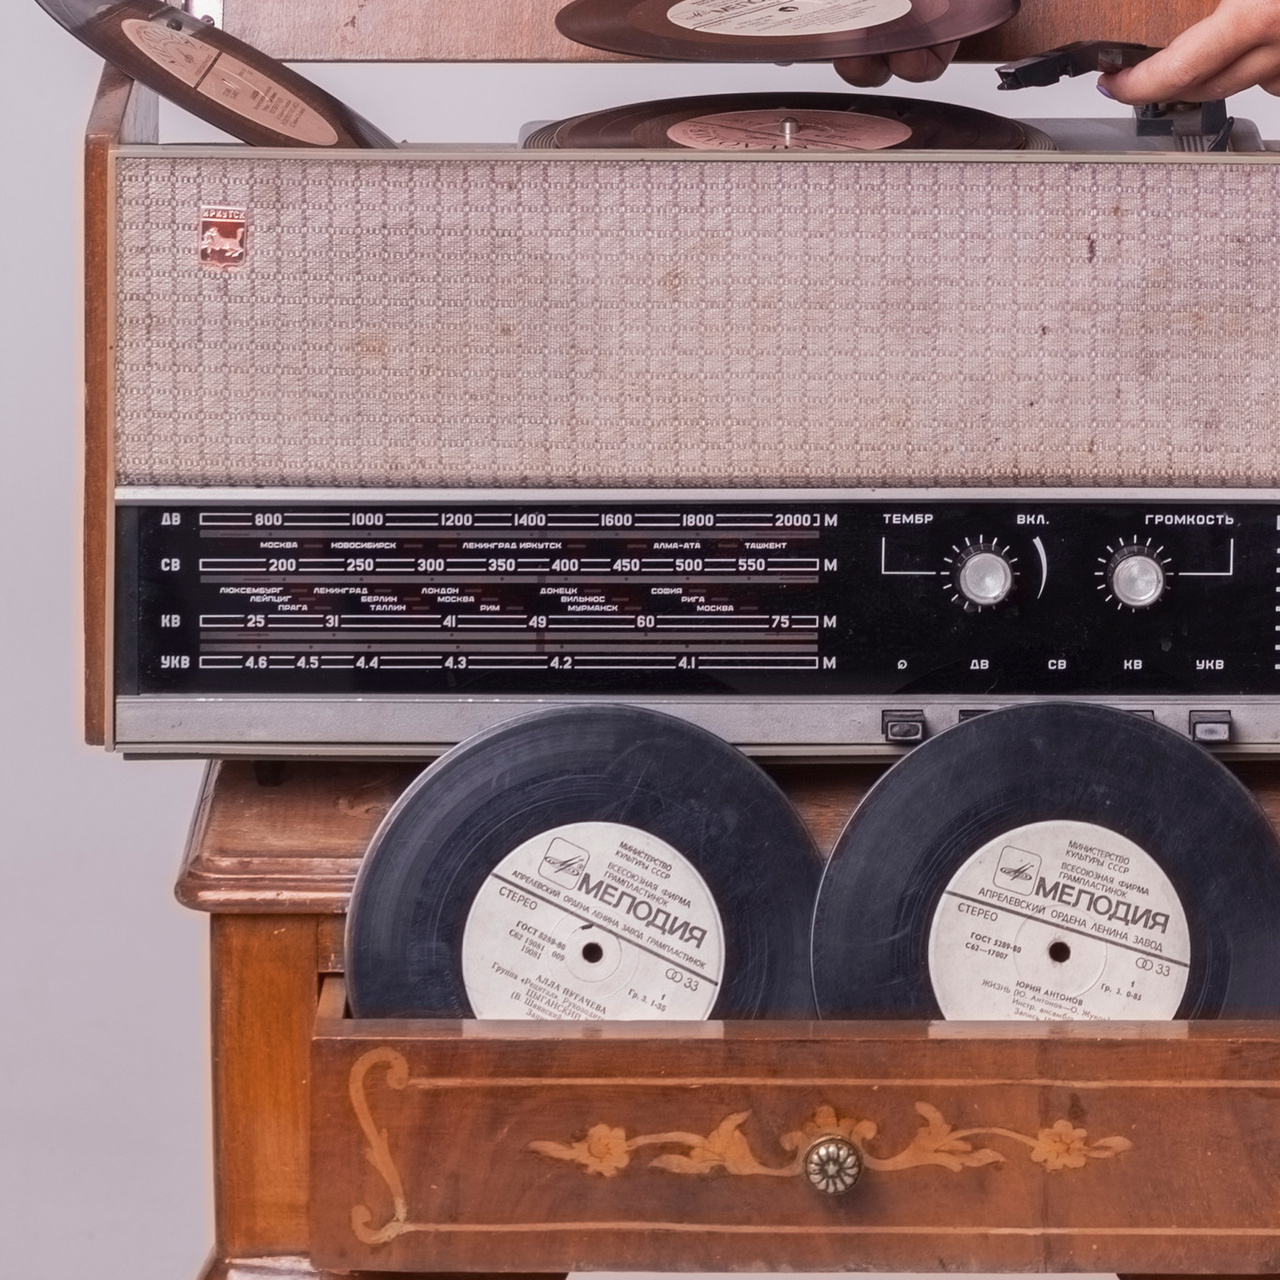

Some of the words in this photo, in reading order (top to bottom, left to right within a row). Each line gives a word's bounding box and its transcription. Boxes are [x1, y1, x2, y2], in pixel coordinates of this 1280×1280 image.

[161, 513, 181, 526] ДВ
[254, 513, 283, 526] 800
[351, 513, 383, 526] 1000
[441, 513, 472, 526] 1200
[514, 514, 546, 527] 1400
[601, 514, 632, 527] 1600
[682, 514, 714, 527] 1800
[775, 514, 811, 527] 2000
[824, 514, 838, 527] М
[883, 514, 934, 525] ТЕМБР
[1017, 515, 1050, 525] ВКЛ.
[1145, 515, 1234, 525] ГРОМКОСТЬ
[260, 541, 298, 549] МОСКВА
[331, 541, 396, 550] НОВОСИБИРСК
[463, 541, 517, 550] ЛЕНИНГРАД
[653, 542, 701, 550] АЛМА-АТА
[745, 542, 787, 550] ТАШКЕНТ
[161, 559, 180, 571] СВ
[268, 559, 297, 572] 200
[346, 559, 374, 572] 250
[417, 559, 445, 572] 300
[488, 559, 516, 572] 350
[551, 559, 579, 572] 400
[612, 559, 640, 572] 450
[675, 559, 703, 572] 500
[738, 559, 766, 572] 550
[824, 560, 837, 571] М
[250, 594, 292, 603] ЛЕЙПЦИГ
[361, 595, 397, 603] БЕРЛИН
[437, 595, 475, 603] МОСКВА
[560, 595, 605, 603] ВИЛЬНЮС
[681, 595, 705, 604] РИГА
[313, 587, 368, 595] ЛЕНИНГРАД
[421, 587, 459, 595] ЛОНДОН
[540, 587, 578, 596] ДОНЕЦК
[651, 587, 682, 595] СОФИЯ
[278, 604, 308, 612] ПРАГА
[369, 604, 406, 612] ТАЛЛИН
[480, 604, 500, 612] РИМ
[568, 604, 618, 612] МУРМАНСК
[696, 604, 734, 612] МОСКВА
[161, 615, 180, 628] КВ
[246, 615, 265, 628] 25
[325, 615, 339, 628] 31
[443, 615, 456, 628] 41
[529, 616, 547, 628] 49
[636, 616, 655, 628] 60
[771, 616, 790, 628] 75
[823, 616, 837, 628] М
[161, 656, 190, 668] УКВ
[244, 656, 267, 669] 4.6
[297, 656, 319, 669] 4.5
[356, 656, 379, 669] 4.4
[444, 656, 467, 669] 4.3
[550, 657, 572, 669] 4.2
[678, 657, 696, 669] 4.1
[823, 657, 836, 669] М
[969, 660, 989, 670] ДВ
[1048, 660, 1067, 670] СВ
[1124, 660, 1142, 670] КВ
[1196, 660, 1224, 670] УКВ
[619, 841, 672, 871] МИНИСТЕРСТВО
[1068, 840, 1130, 865] МИНИСТЕРСТВО
[615, 850, 649, 870] КУЛЬТУРЫ
[651, 865, 671, 880] СССР
[1065, 849, 1105, 867] КУЛЬТУРЫ
[1107, 861, 1130, 875] СССР
[607, 861, 660, 891] ВСЕСОЮЗНАЯ
[661, 887, 692, 908] ФИРМА
[1058, 871, 1129, 899] ГРАМПЛАСТИНОК
[1060, 862, 1115, 885] ВСЕСОЮЗНАЯ
[1117, 879, 1149, 896] ФИРМА
[604, 871, 669, 907] ГРАМПЛАСТИНОК
[498, 886, 538, 911] СТЕРЕО
[1034, 877, 1170, 934] МЕЛОДИЯ
[578, 871, 707, 949] МЕЛОДИЯ
[957, 902, 999, 922] СТЕРЕО
[511, 870, 561, 899] АПРЕЛЕВСКИЙ
[563, 894, 590, 913] ОРДЕНА
[591, 908, 620, 928] ЛЕНИНА
[621, 922, 644, 940] ЗАВОД
[646, 936, 707, 970] ГРАМПЛАСТИНОК
[978, 887, 1046, 915] АПРЕЛЕВСКИЙ
[1050, 909, 1087, 929] ОРДЕНА
[1090, 920, 1129, 942] ЛЕНИНА
[1132, 934, 1163, 953] ЗАВОД
[516, 920, 538, 936] ГОСТ
[970, 932, 992, 945] ГОСТ
[491, 961, 518, 980] Группа
[1155, 963, 1171, 977] 33
[684, 977, 699, 992] 33
[981, 979, 1011, 994] ЖИЗНЬ
[1100, 983, 1112, 994] Гр.
[536, 974, 561, 991] АЛЛА
[562, 987, 607, 1015] ПУГАЧЕВА
[1016, 980, 1042, 994] ЮРИЙ
[1044, 990, 1084, 1006] АНТОНОВ
[1012, 998, 1036, 1011] Инстр.
